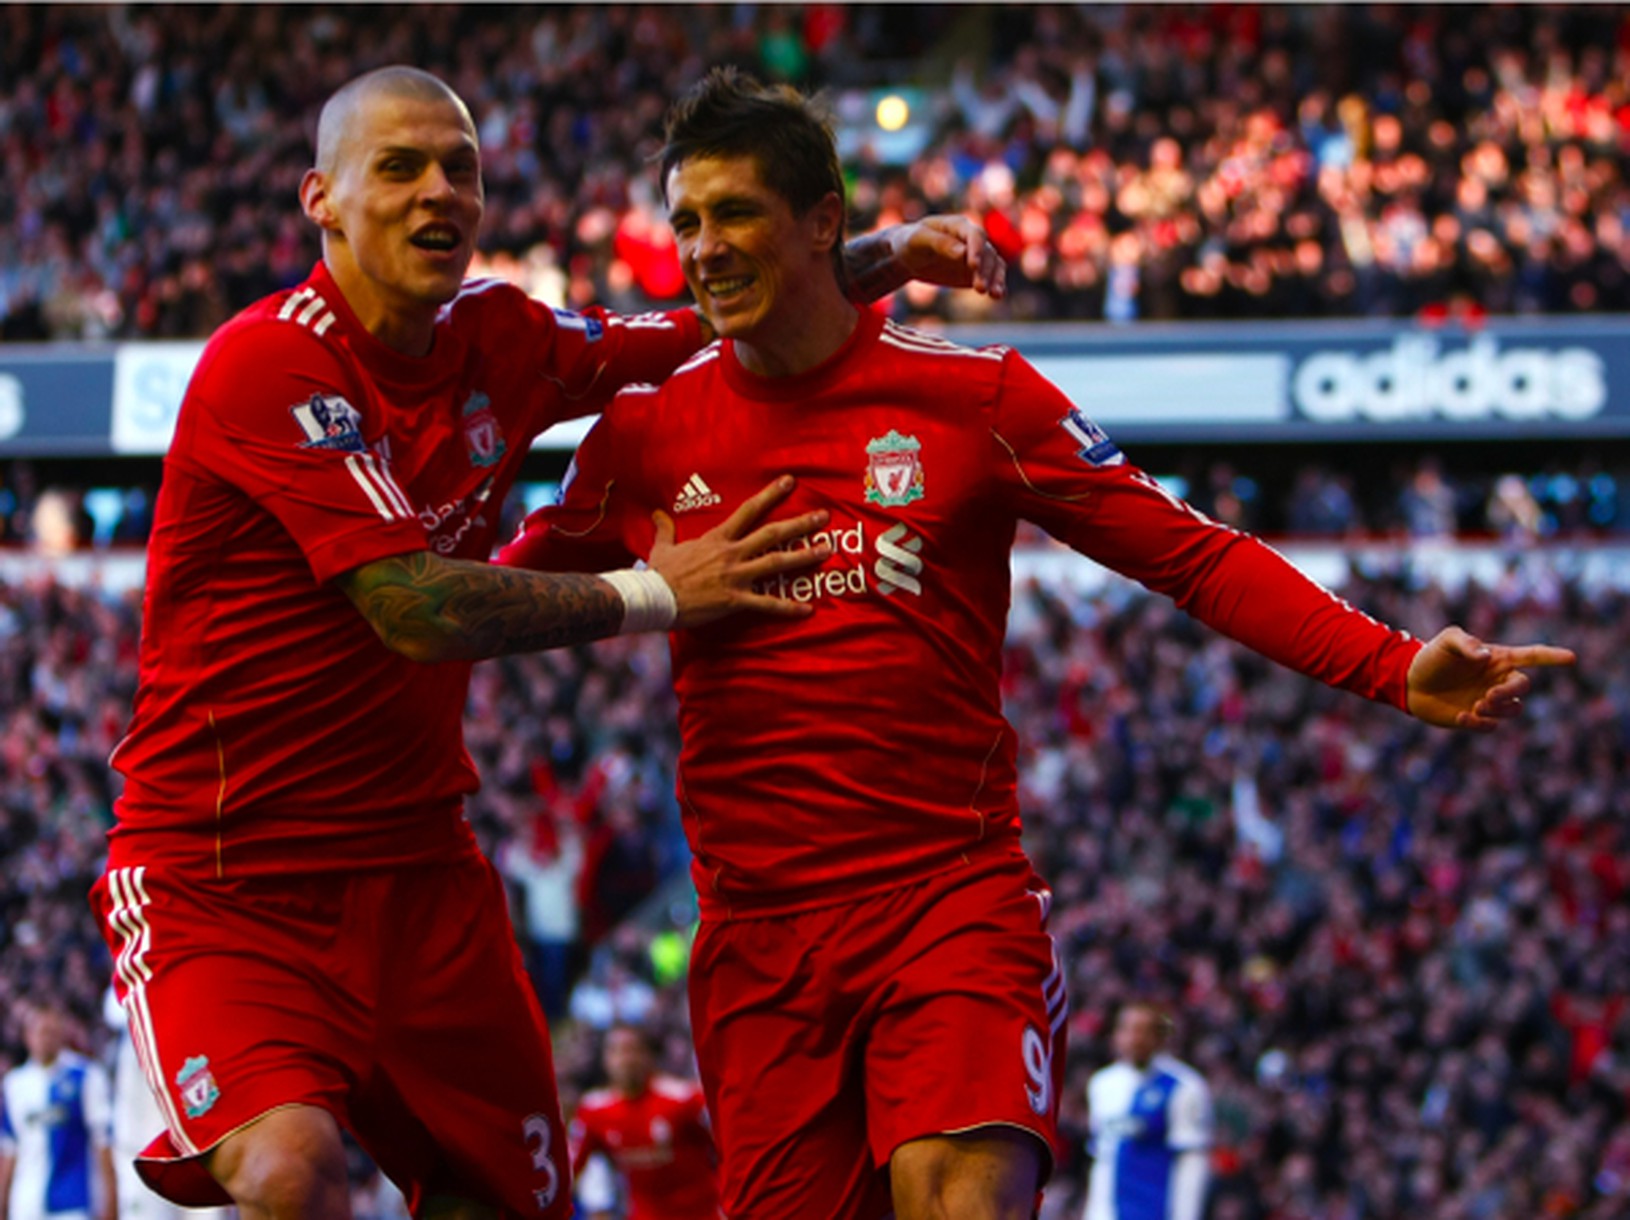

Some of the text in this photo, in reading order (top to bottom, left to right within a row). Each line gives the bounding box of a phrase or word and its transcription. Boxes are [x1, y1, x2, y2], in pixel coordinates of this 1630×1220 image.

[1295, 331, 1608, 421] adidas
[1022, 1026, 1050, 1116] 9
[522, 1113, 558, 1211] 3
